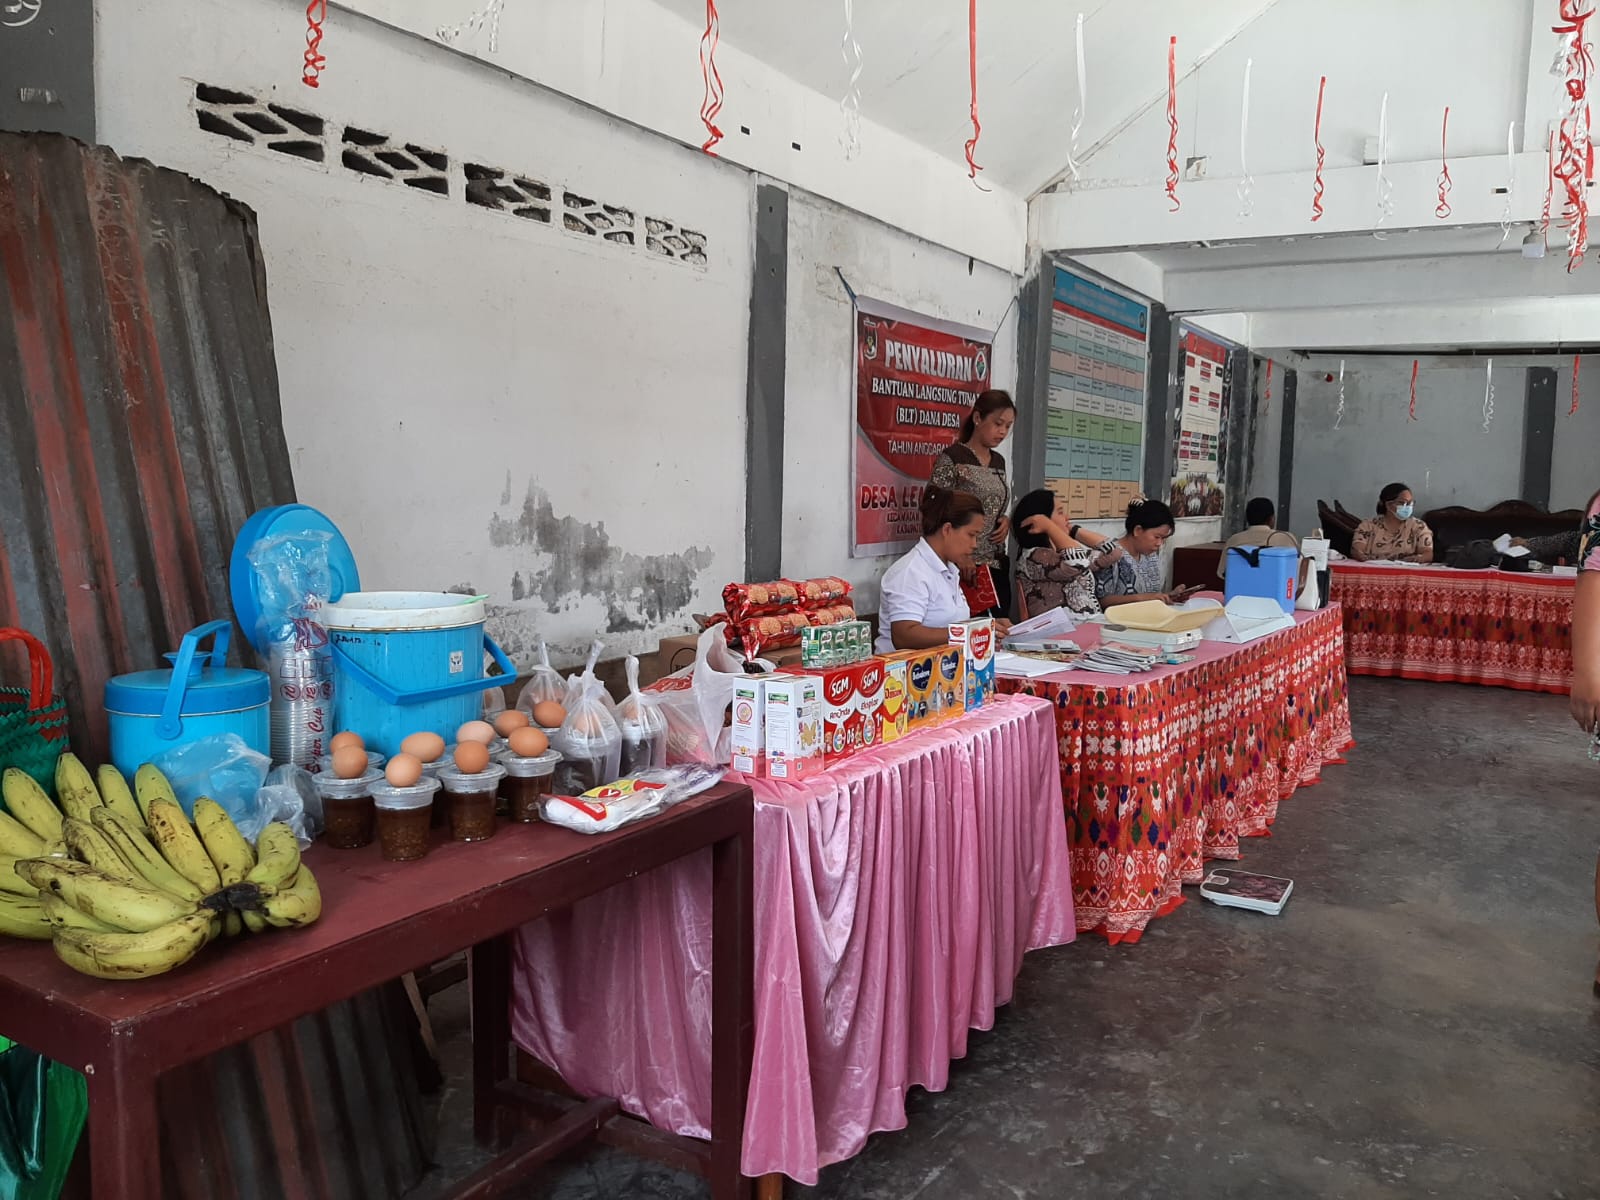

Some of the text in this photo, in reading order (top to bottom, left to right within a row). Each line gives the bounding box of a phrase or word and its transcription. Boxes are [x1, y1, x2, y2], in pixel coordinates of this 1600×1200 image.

[884, 339, 972, 383] PENYALURAN
[872, 377, 914, 399] BANTUAN
[915, 383, 957, 404] LANGSUNG
[896, 405, 961, 428] (BLT) DANA DESA
[887, 439, 913, 455] TAHUN
[861, 483, 898, 510] DESA
[831, 676, 849, 697] SGM
[863, 669, 879, 691] SGM
[307, 706, 325, 733] Cup
